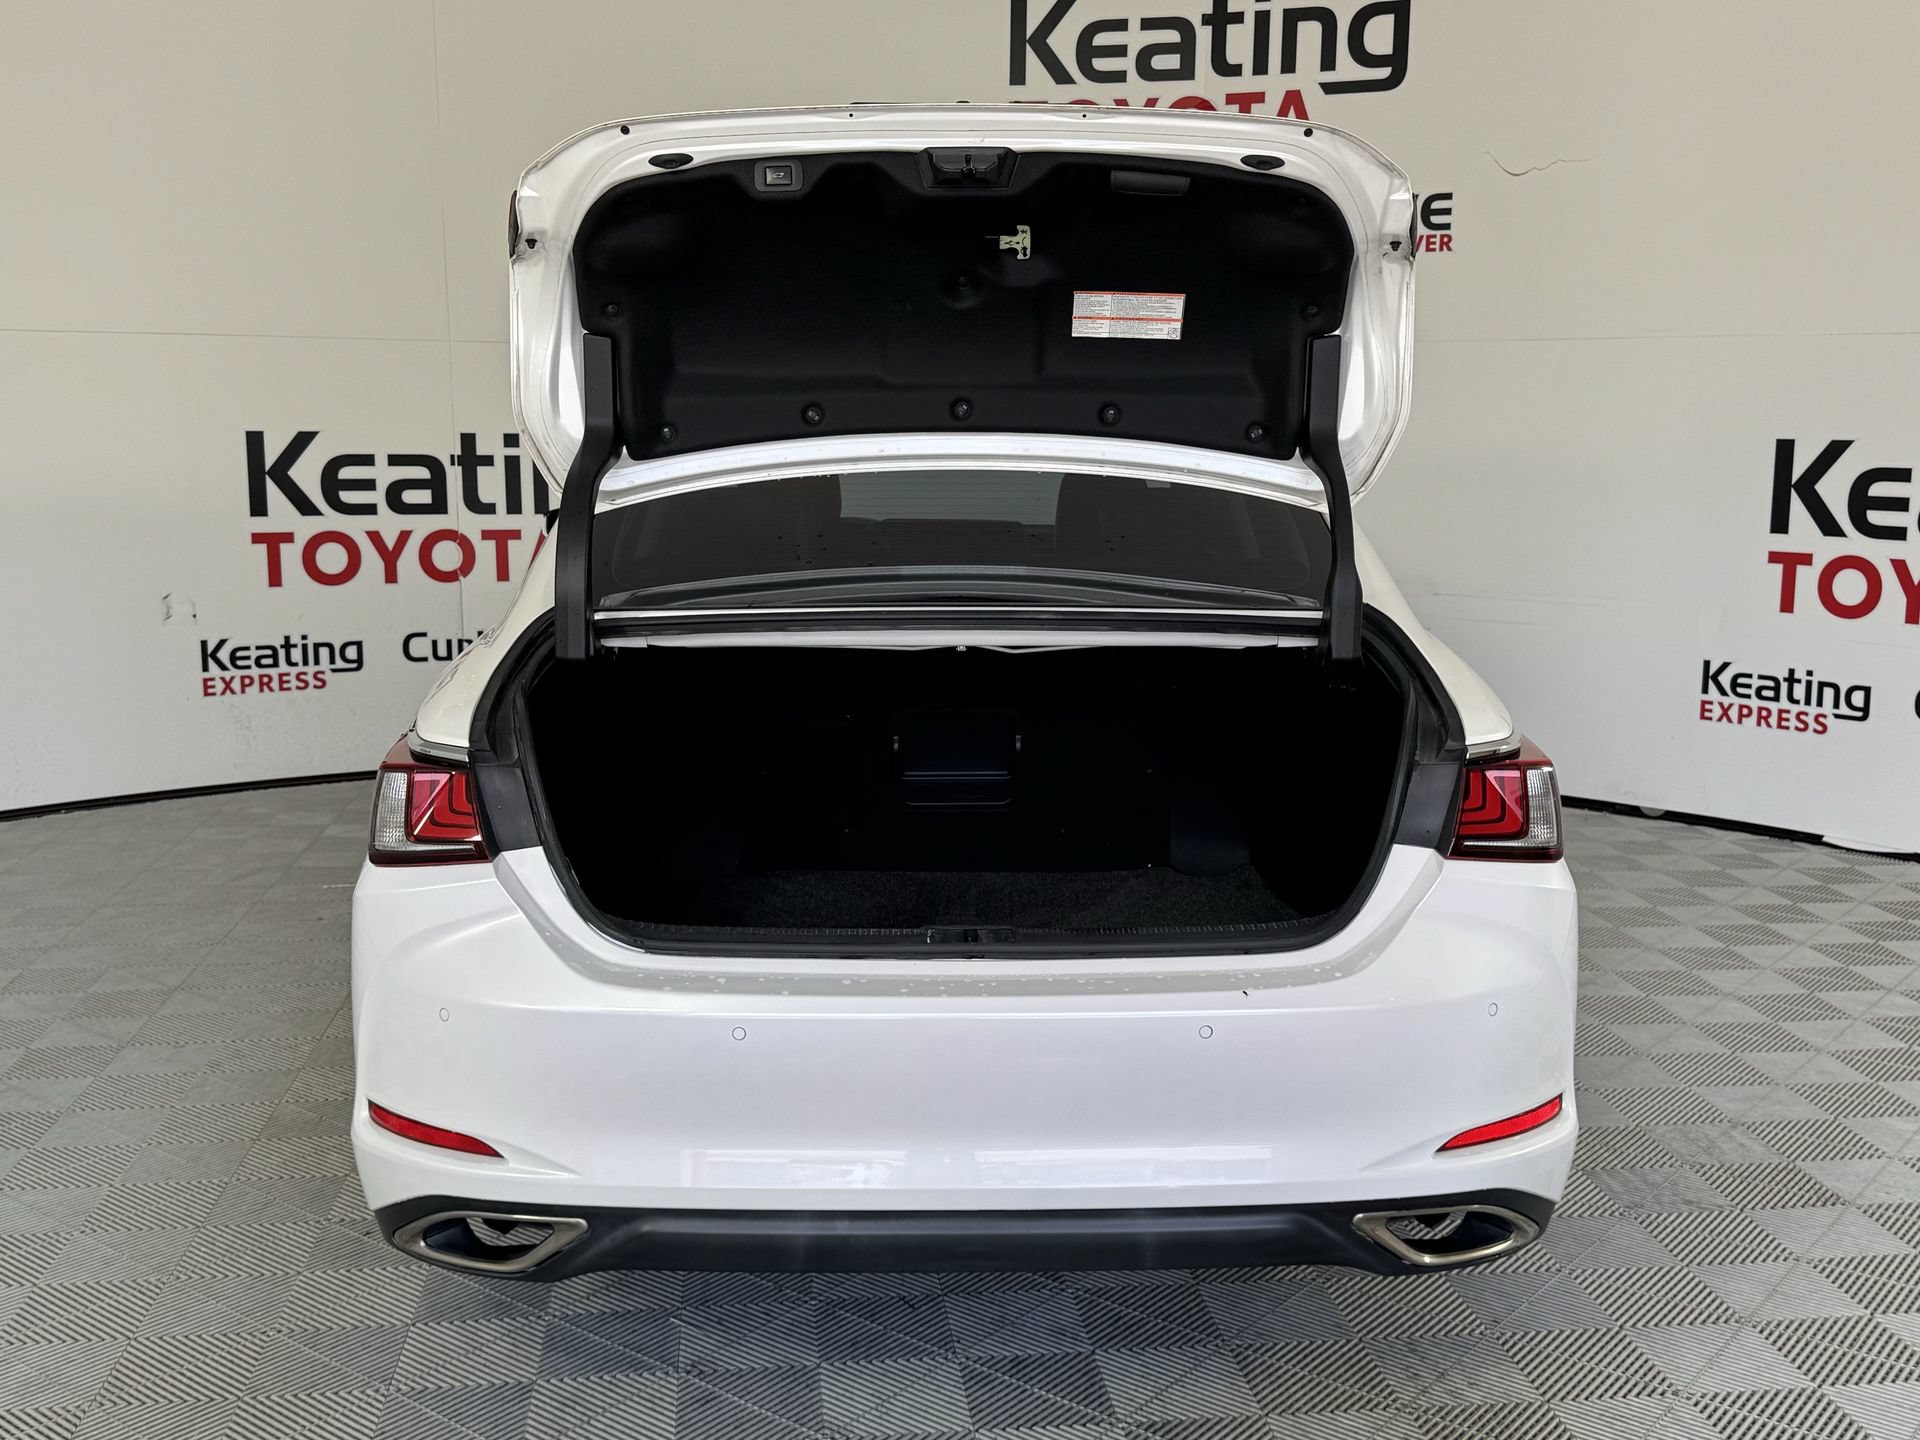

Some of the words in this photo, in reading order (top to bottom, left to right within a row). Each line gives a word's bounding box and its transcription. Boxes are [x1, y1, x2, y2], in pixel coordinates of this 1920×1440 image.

[1009, 0, 1412, 96] Keating
[245, 430, 550, 518] Keati
[200, 633, 364, 674] Keating
[202, 671, 328, 697] EXPRESS
[1700, 659, 1872, 723] Keating
[1699, 699, 1829, 735] EXPRESS
